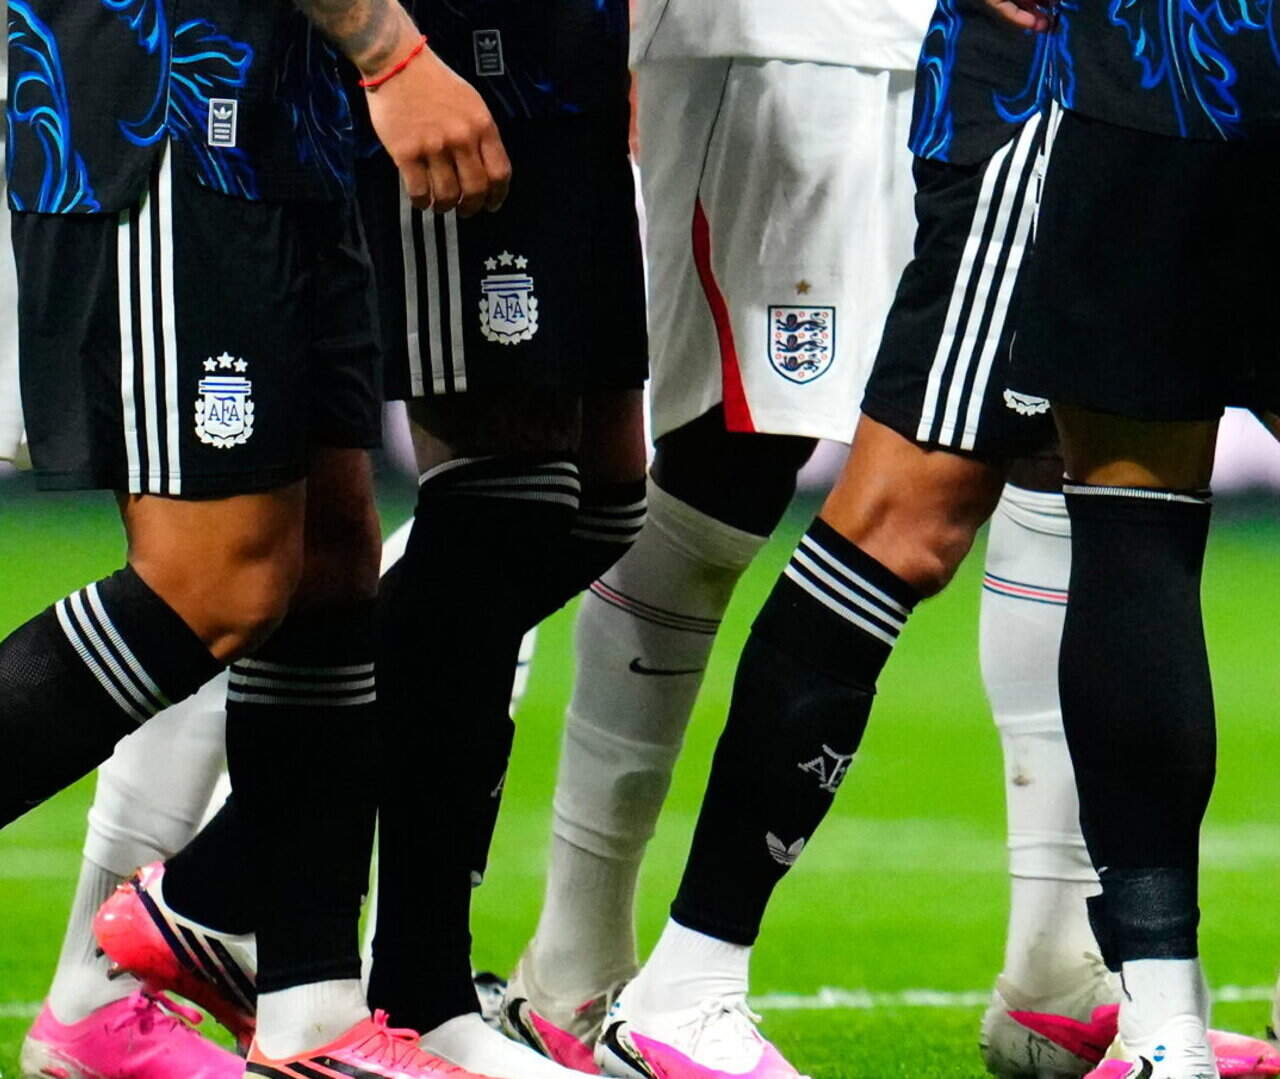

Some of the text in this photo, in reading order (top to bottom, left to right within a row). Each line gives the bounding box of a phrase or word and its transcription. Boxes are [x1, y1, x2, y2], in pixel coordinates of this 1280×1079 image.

[492, 292, 526, 325] AFA
[207, 395, 241, 427] AFA
[797, 744, 856, 793] AF
